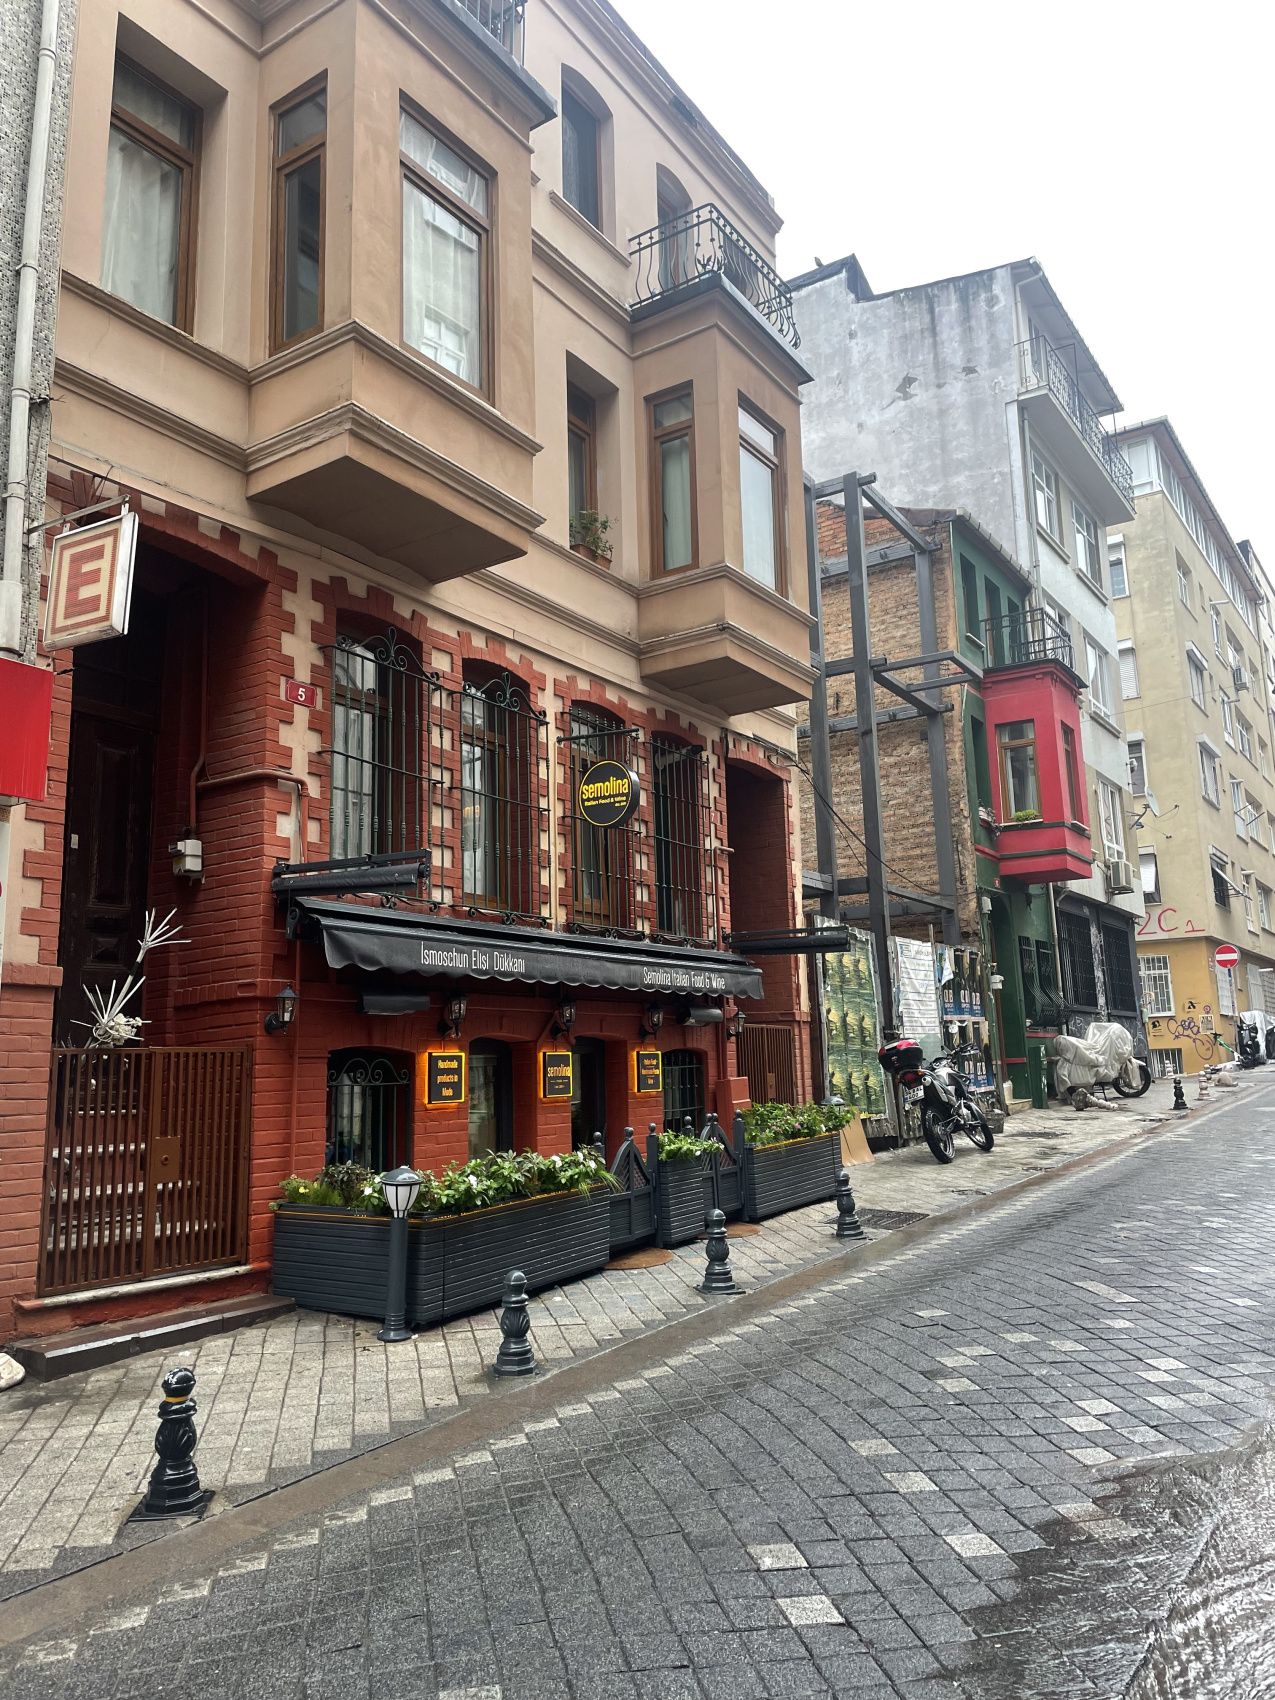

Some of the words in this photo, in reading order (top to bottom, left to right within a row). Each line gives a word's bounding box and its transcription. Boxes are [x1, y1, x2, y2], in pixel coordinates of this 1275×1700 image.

[63, 543, 105, 620] E
[297, 687, 306, 701] 5
[582, 776, 629, 799] semolina
[643, 967, 671, 986] Semolina
[671, 970, 690, 986] Italian
[691, 971, 705, 988] Food
[710, 974, 726, 989] Wine
[547, 1063, 571, 1077] semolina
